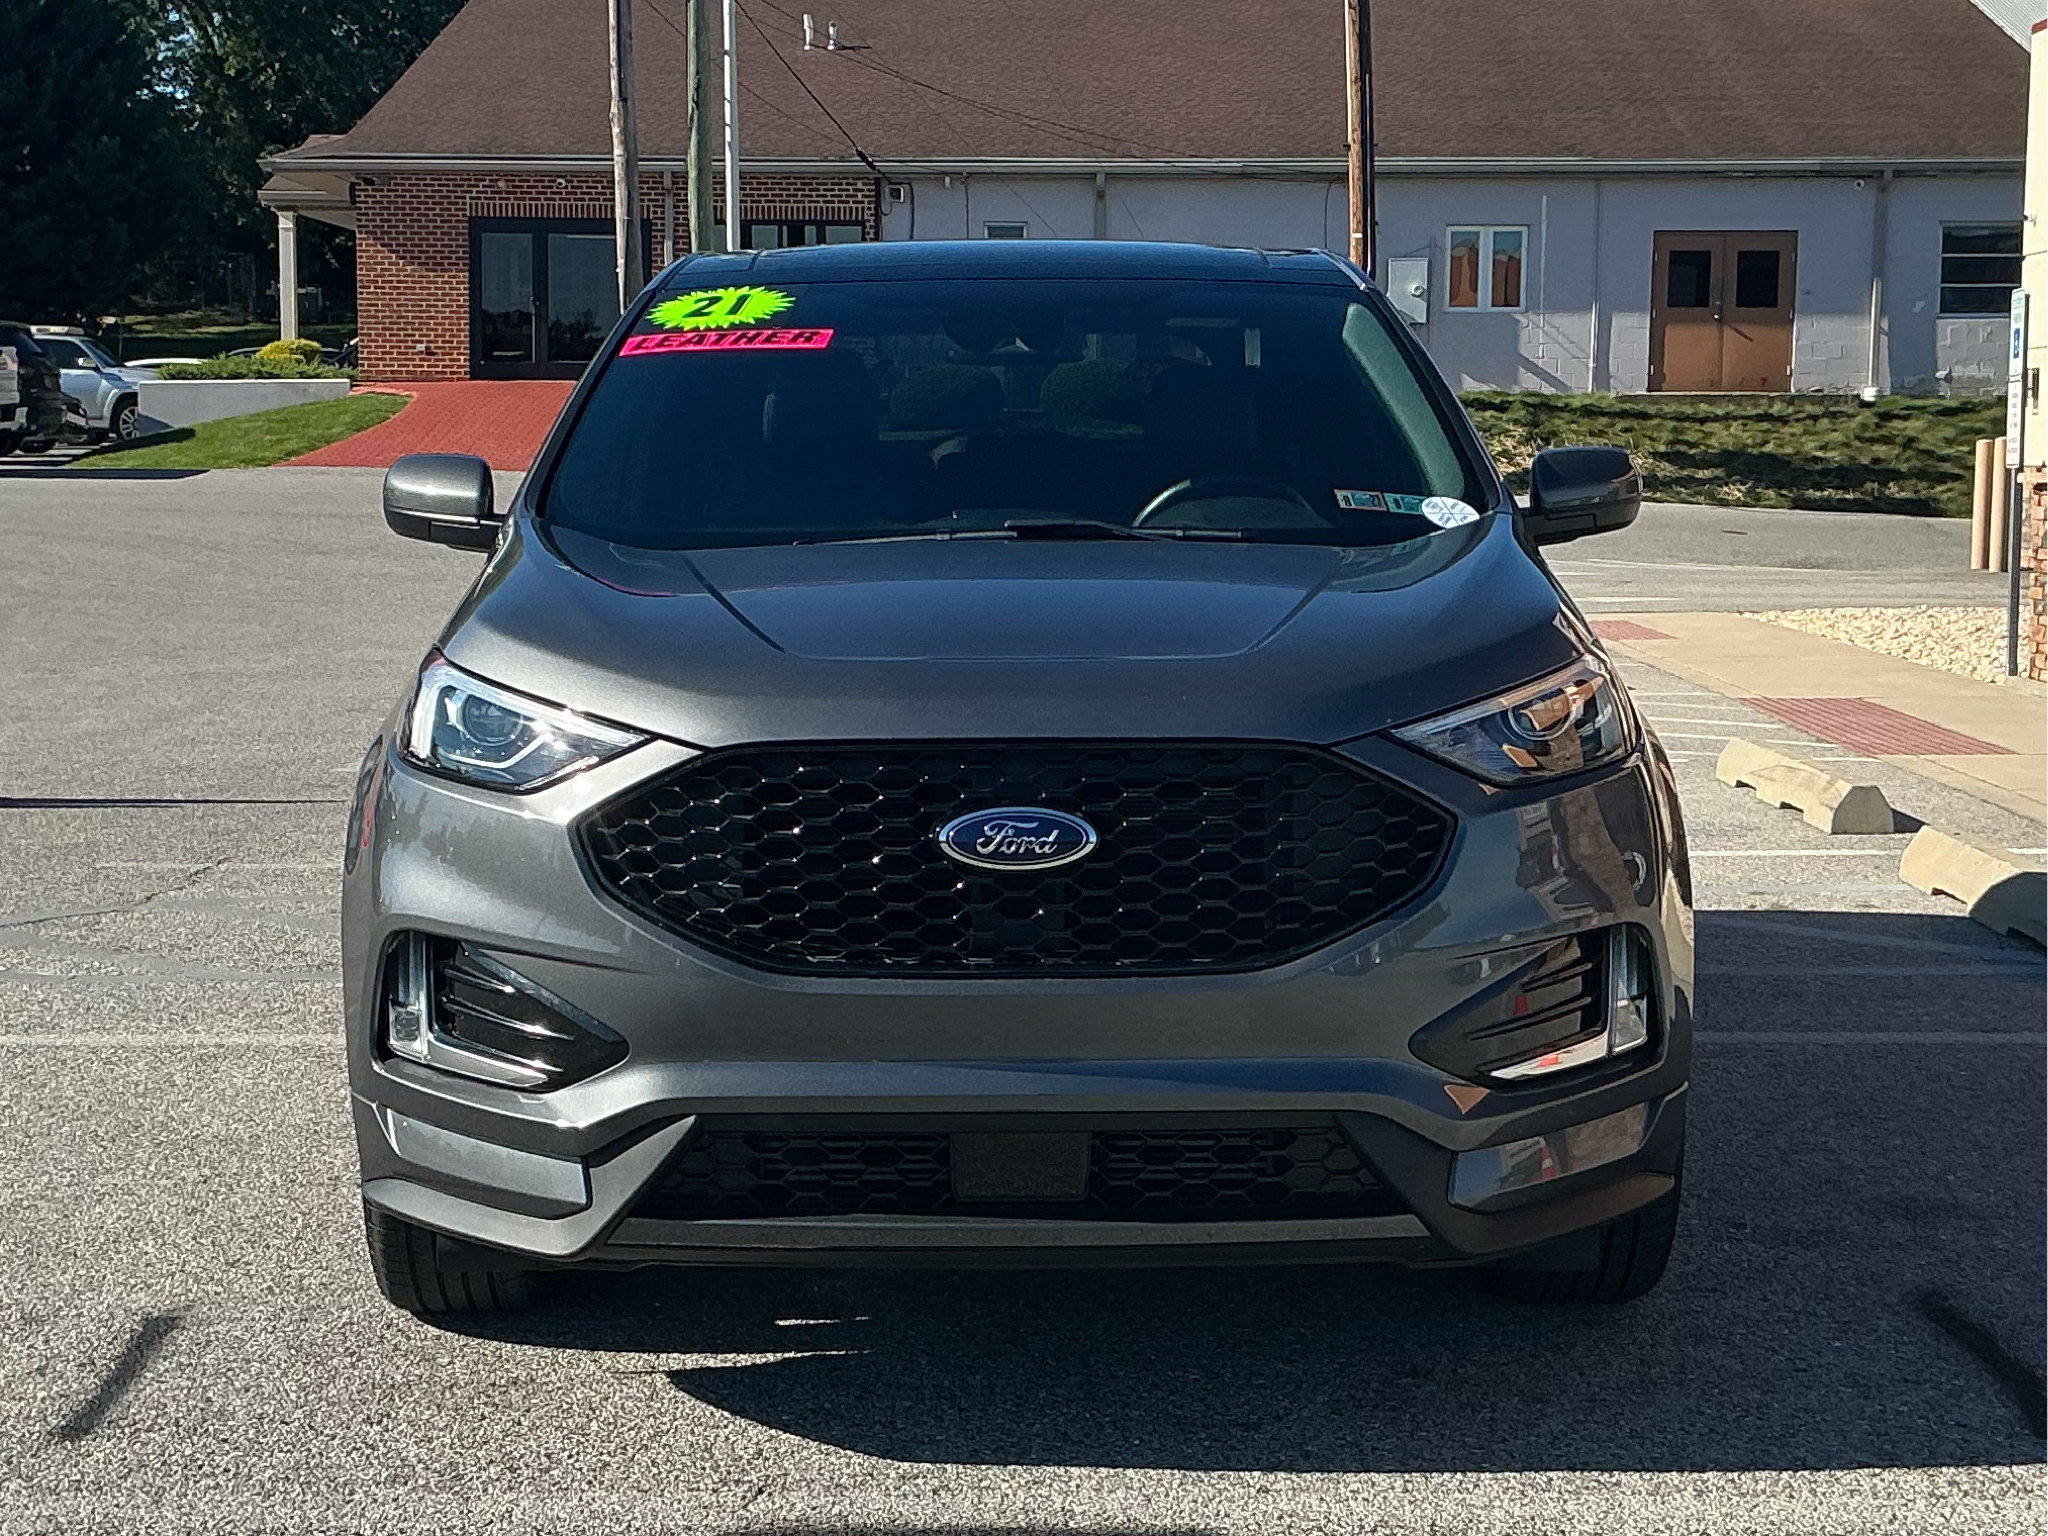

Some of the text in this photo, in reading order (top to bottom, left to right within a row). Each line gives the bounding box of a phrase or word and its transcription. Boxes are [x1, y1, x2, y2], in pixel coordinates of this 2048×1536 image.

[682, 294, 751, 318] 21
[633, 331, 820, 351] LEATHER
[976, 820, 1059, 854] Ford
